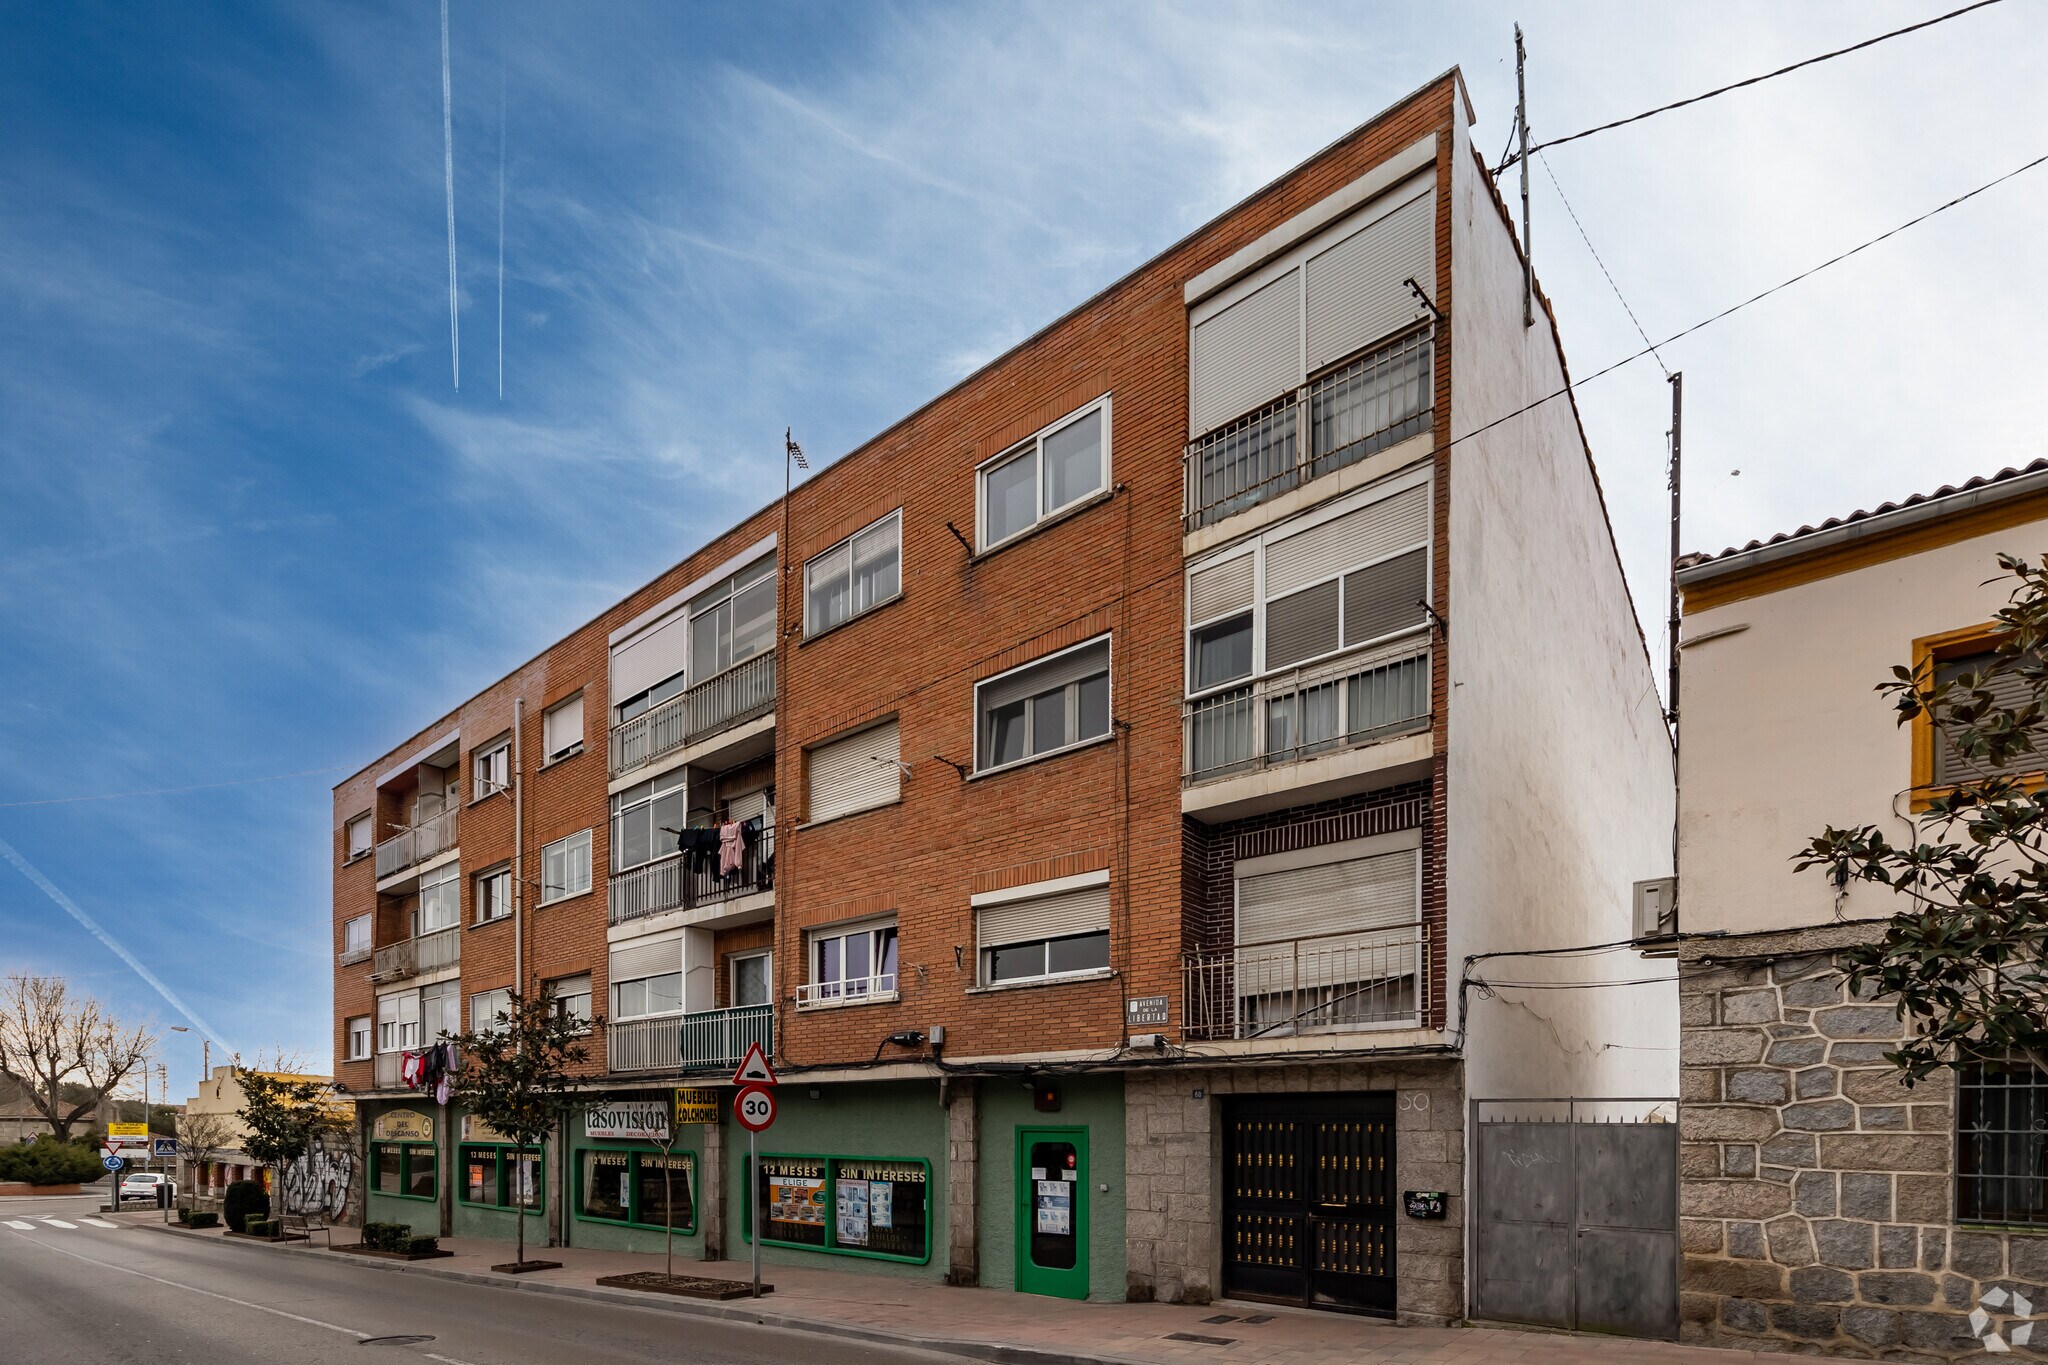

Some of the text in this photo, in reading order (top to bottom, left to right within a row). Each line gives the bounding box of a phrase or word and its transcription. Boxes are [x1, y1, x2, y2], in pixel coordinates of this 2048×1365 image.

[1139, 999, 1163, 1007] AVENIDA
[678, 1090, 717, 1105] MUEBLES
[745, 1100, 769, 1116] 30
[390, 1111, 416, 1119] CENTRO
[678, 1107, 718, 1122] COLCHONES
[396, 1120, 409, 1128] DEL
[385, 1130, 420, 1138] DESCANSO
[470, 1151, 497, 1160] 12 MESES
[506, 1152, 515, 1160] SIN
[590, 1156, 627, 1166] 12 MESES
[640, 1158, 653, 1168] SIN
[763, 1165, 818, 1177] 12 MESES
[840, 1168, 858, 1180] SIN
[863, 1169, 926, 1183] INTERESES
[782, 1178, 808, 1187] ELIGE
